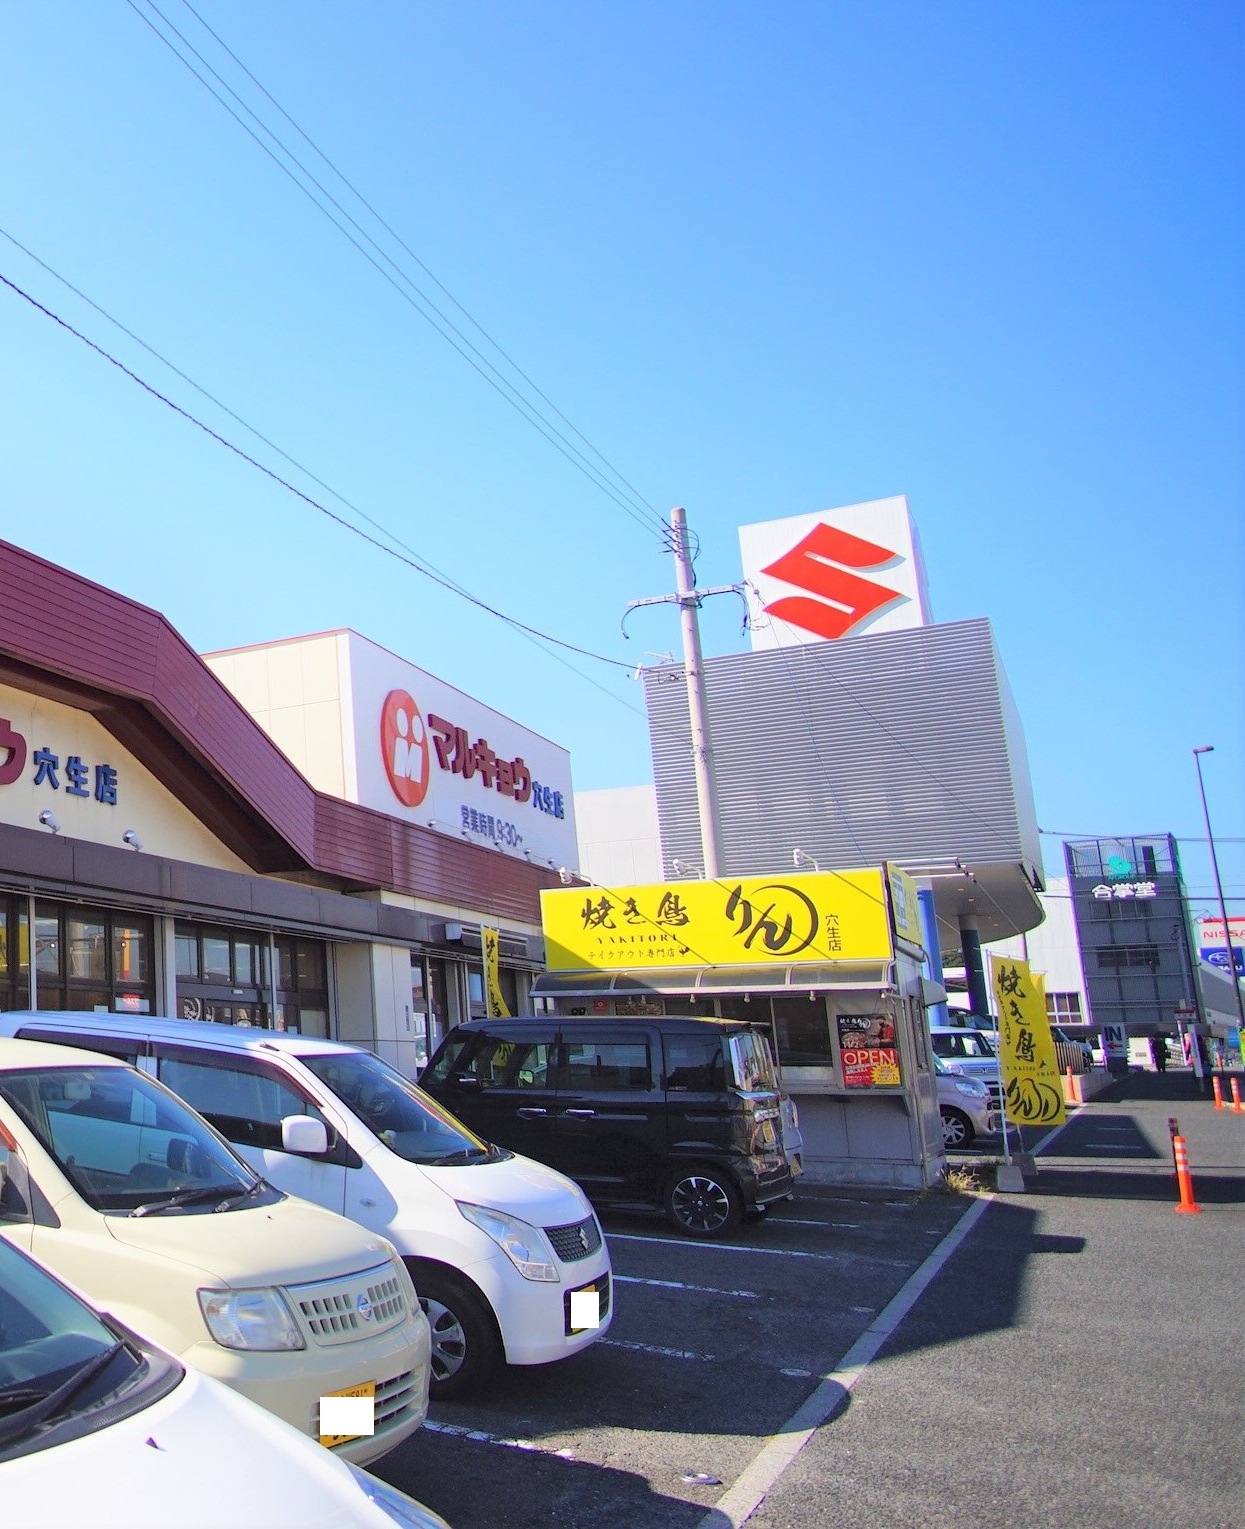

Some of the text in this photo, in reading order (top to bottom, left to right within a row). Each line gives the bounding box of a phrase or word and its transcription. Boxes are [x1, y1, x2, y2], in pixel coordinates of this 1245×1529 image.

[33, 747, 117, 806] 穴生店
[428, 713, 564, 820] マルキョウ 穴生店
[461, 804, 495, 840] 営業時間
[580, 891, 690, 931] 焼き鳥
[597, 934, 678, 945] YAKITORI
[825, 914, 842, 952] 穴生店
[588, 948, 675, 960] テイクアウト専門店
[998, 964, 1037, 1063] 焼き鳥
[1104, 1026, 1122, 1042] IN
[844, 1050, 896, 1065] OPEN
